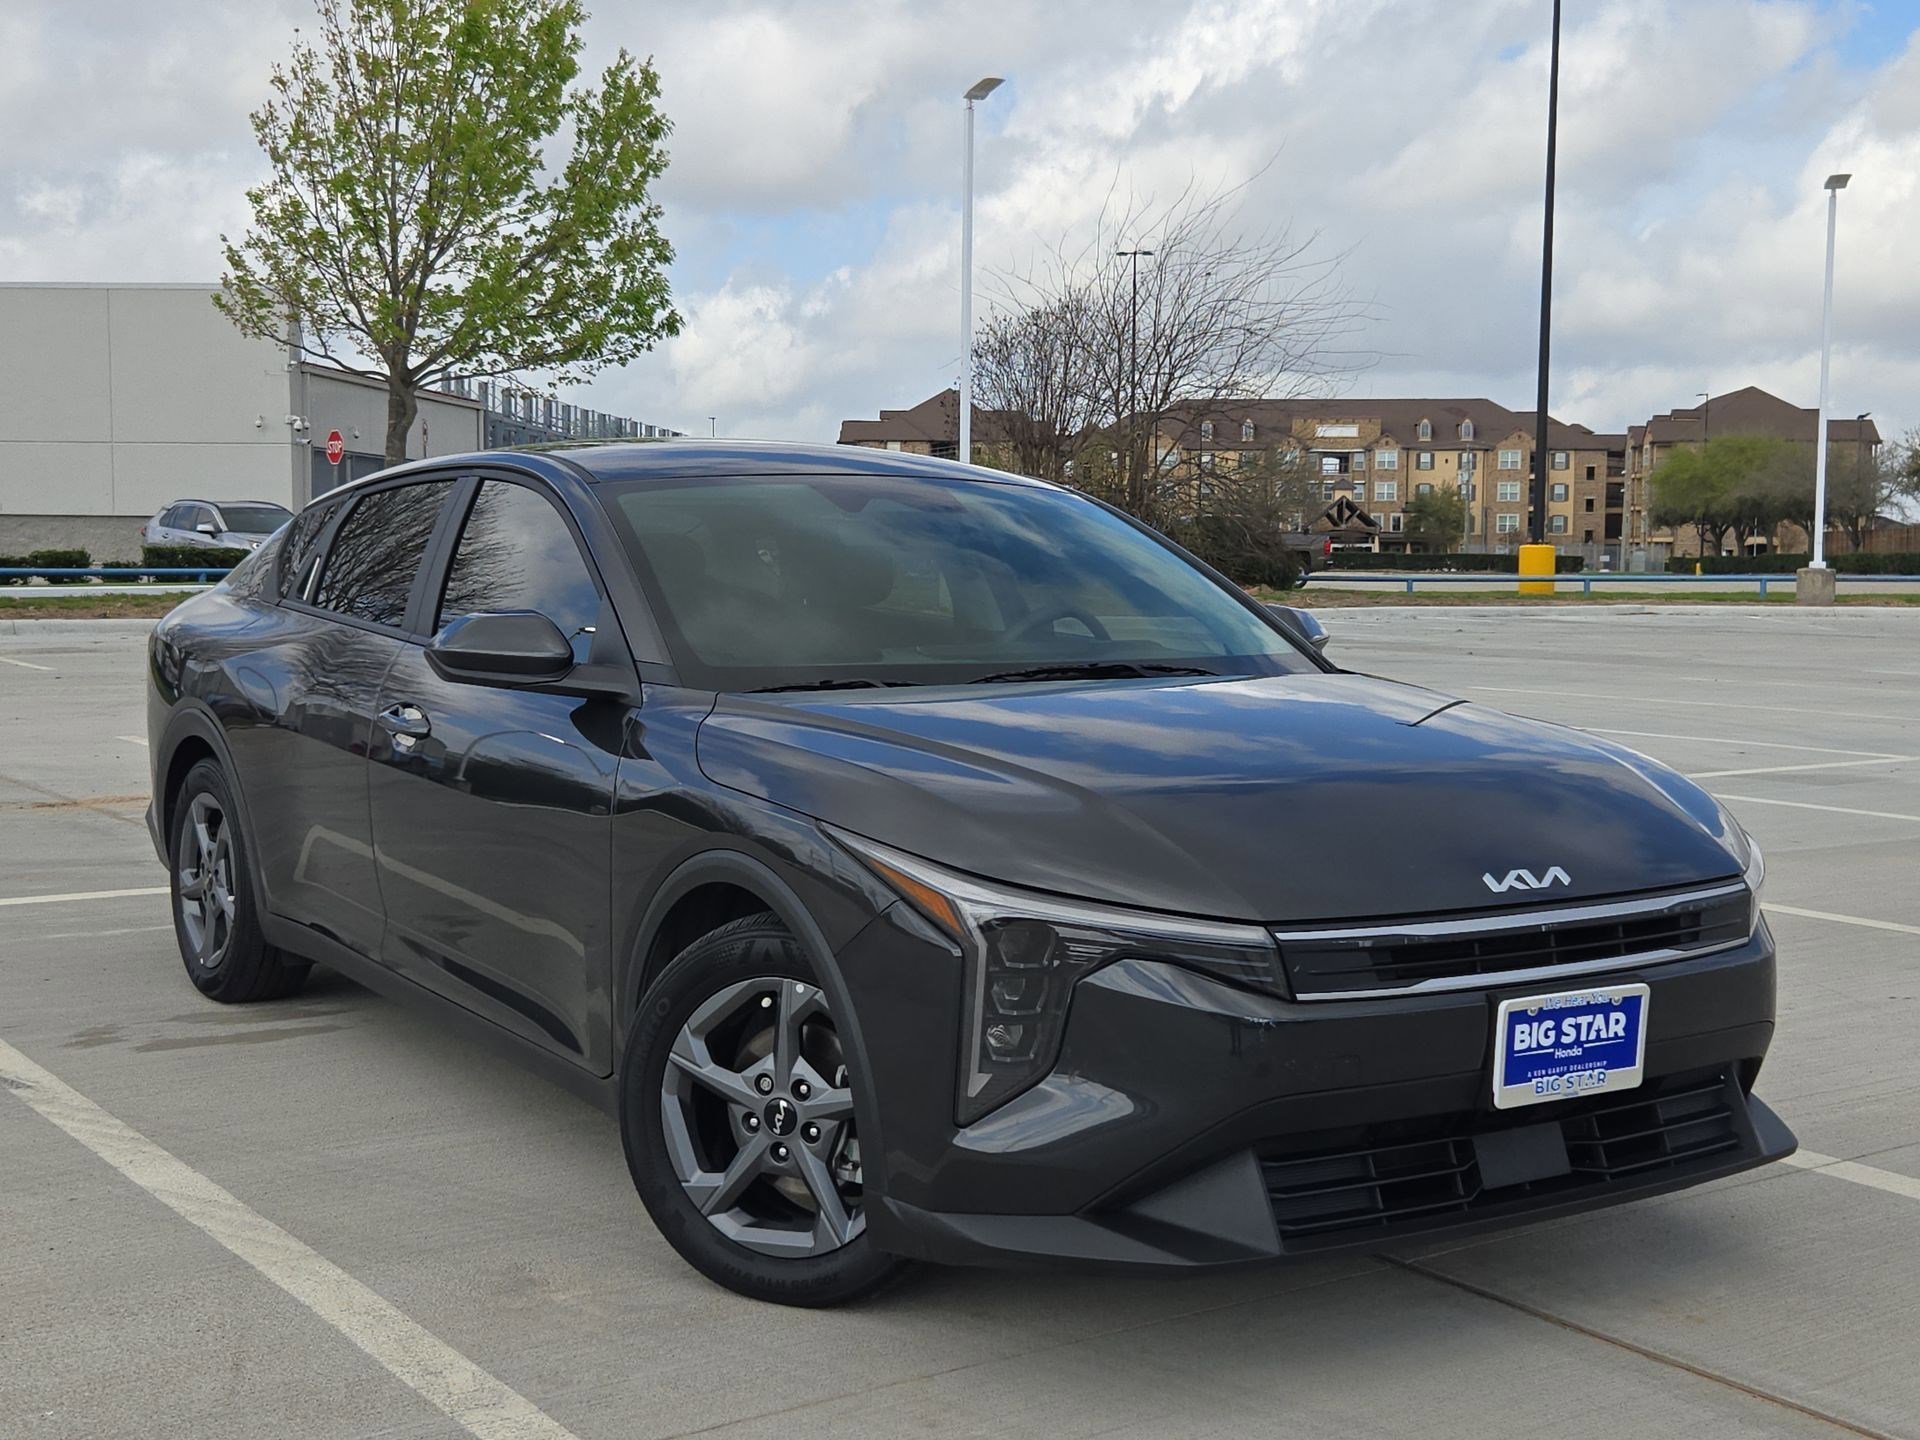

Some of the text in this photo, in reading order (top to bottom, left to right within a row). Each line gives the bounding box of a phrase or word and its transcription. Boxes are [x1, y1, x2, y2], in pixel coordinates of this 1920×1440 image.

[329, 441, 343, 454] STOP
[1514, 1013, 1626, 1051] BIG STAR
[1554, 1045, 1583, 1059] Honda
[1535, 1071, 1606, 1094] BIG STAR
